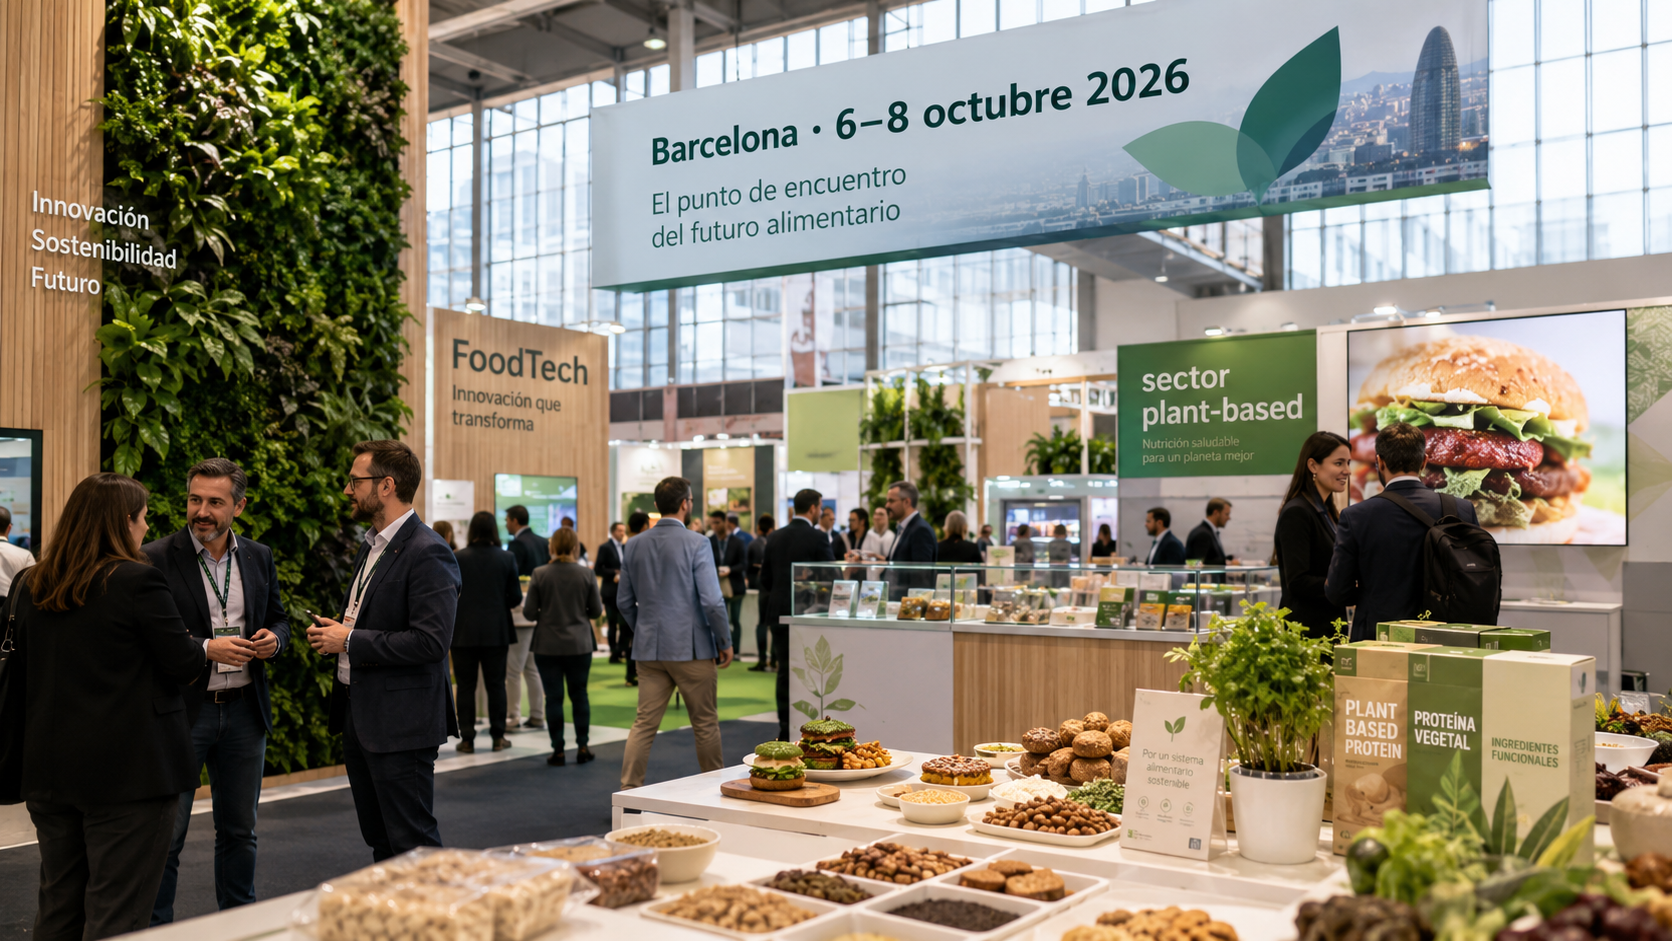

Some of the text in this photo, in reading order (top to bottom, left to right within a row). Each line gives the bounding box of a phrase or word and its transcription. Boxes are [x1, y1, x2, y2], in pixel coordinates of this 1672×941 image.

[652, 125, 798, 166] Barcelona
[923, 82, 1072, 129] octubre
[1086, 58, 1190, 106] 2026
[652, 166, 907, 217] El punto de encuentro
[33, 190, 149, 230] Innovación
[652, 200, 900, 248] del futuro alimentario
[31, 228, 177, 270] Sostenibilidad
[31, 266, 100, 295] Futuro
[453, 338, 588, 386] FoodTech
[1142, 366, 1230, 392] sector
[453, 384, 561, 414] Innovación que
[452, 409, 534, 432] transforma
[1142, 393, 1303, 432] plant-based
[1142, 436, 1240, 449] Nutrición saludable
[1142, 450, 1255, 465] para un planeta mejor
[1345, 699, 1397, 719] PLANT
[1345, 719, 1398, 740] BASED
[1414, 710, 1476, 733] PROTEÍNA
[1345, 739, 1402, 759] PROTEIN
[1414, 728, 1471, 751] VEGETAL
[1491, 737, 1559, 755] INGREDIENTES
[1142, 748, 1204, 765] Por un sistema
[1491, 750, 1559, 768] FUNCIONALES
